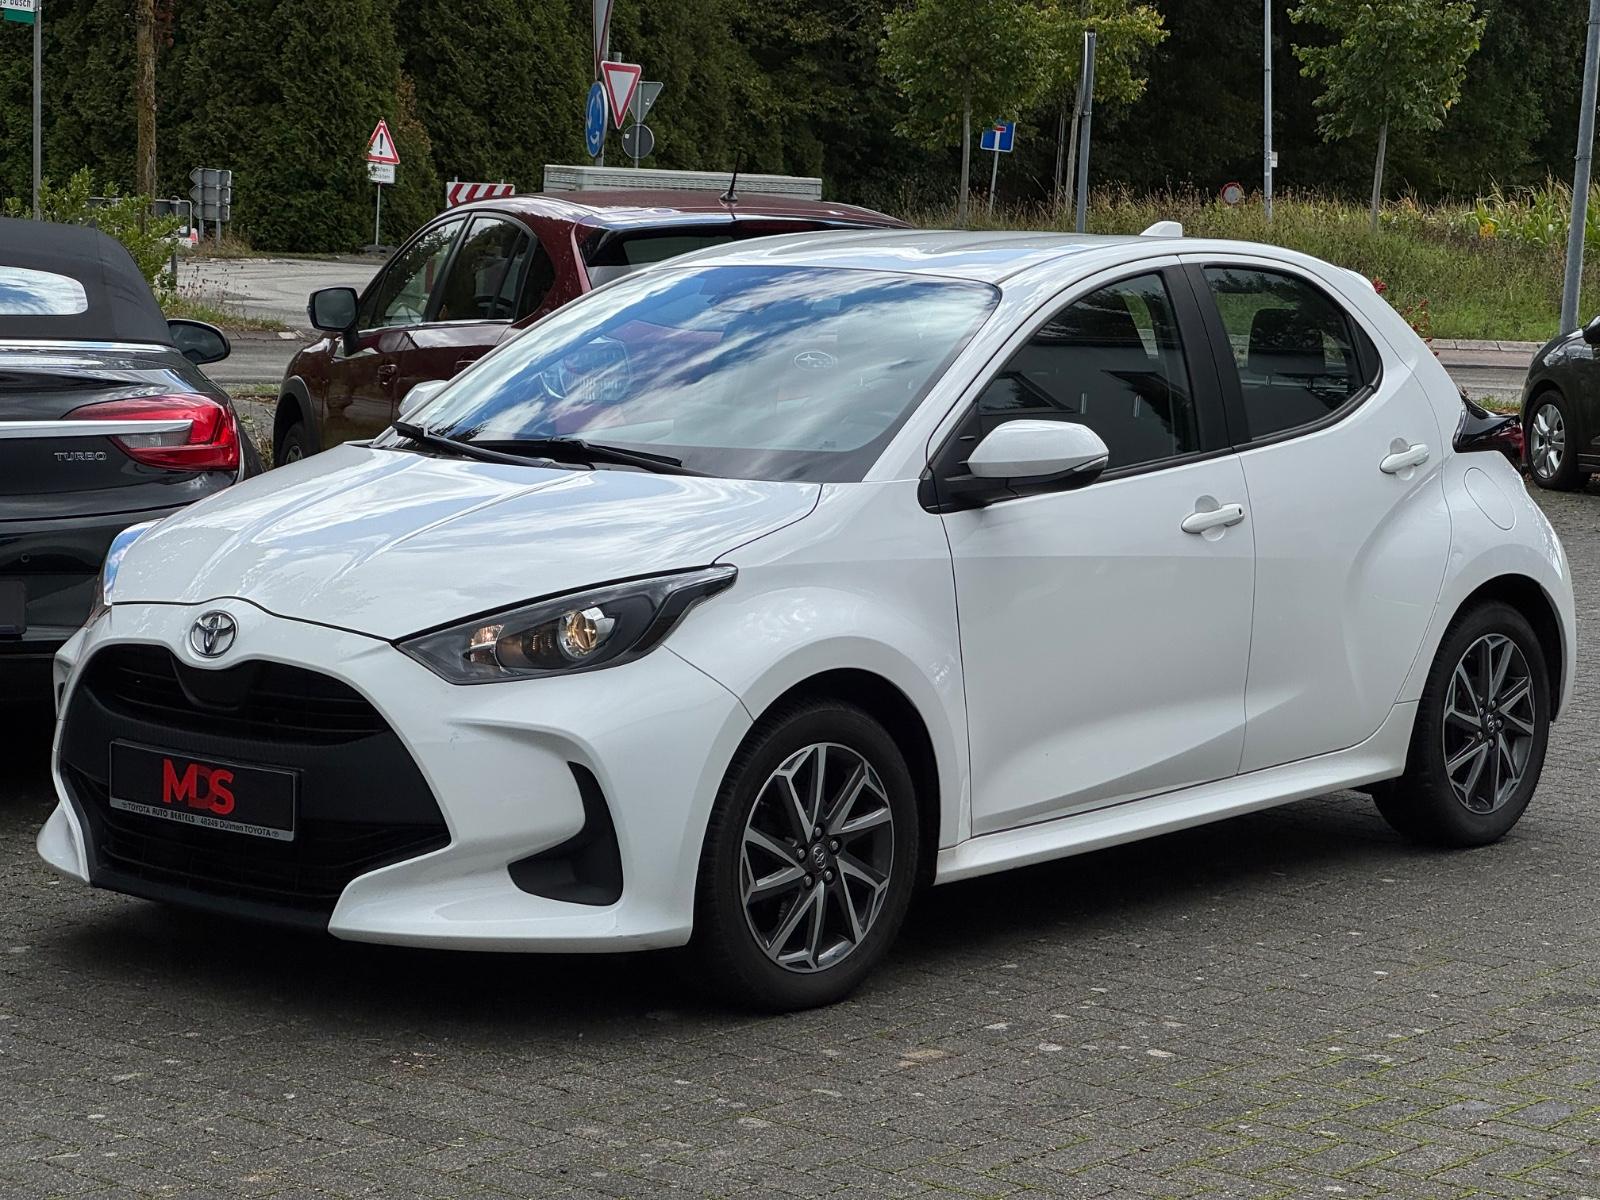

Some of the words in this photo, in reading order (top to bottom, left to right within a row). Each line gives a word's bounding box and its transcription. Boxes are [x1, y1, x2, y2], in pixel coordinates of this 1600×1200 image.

[53, 451, 107, 462] TURBO
[163, 758, 235, 815] MDS
[127, 802, 151, 814] TOYOTA
[152, 807, 169, 818] AUTO
[244, 826, 271, 837] TOYOTA
